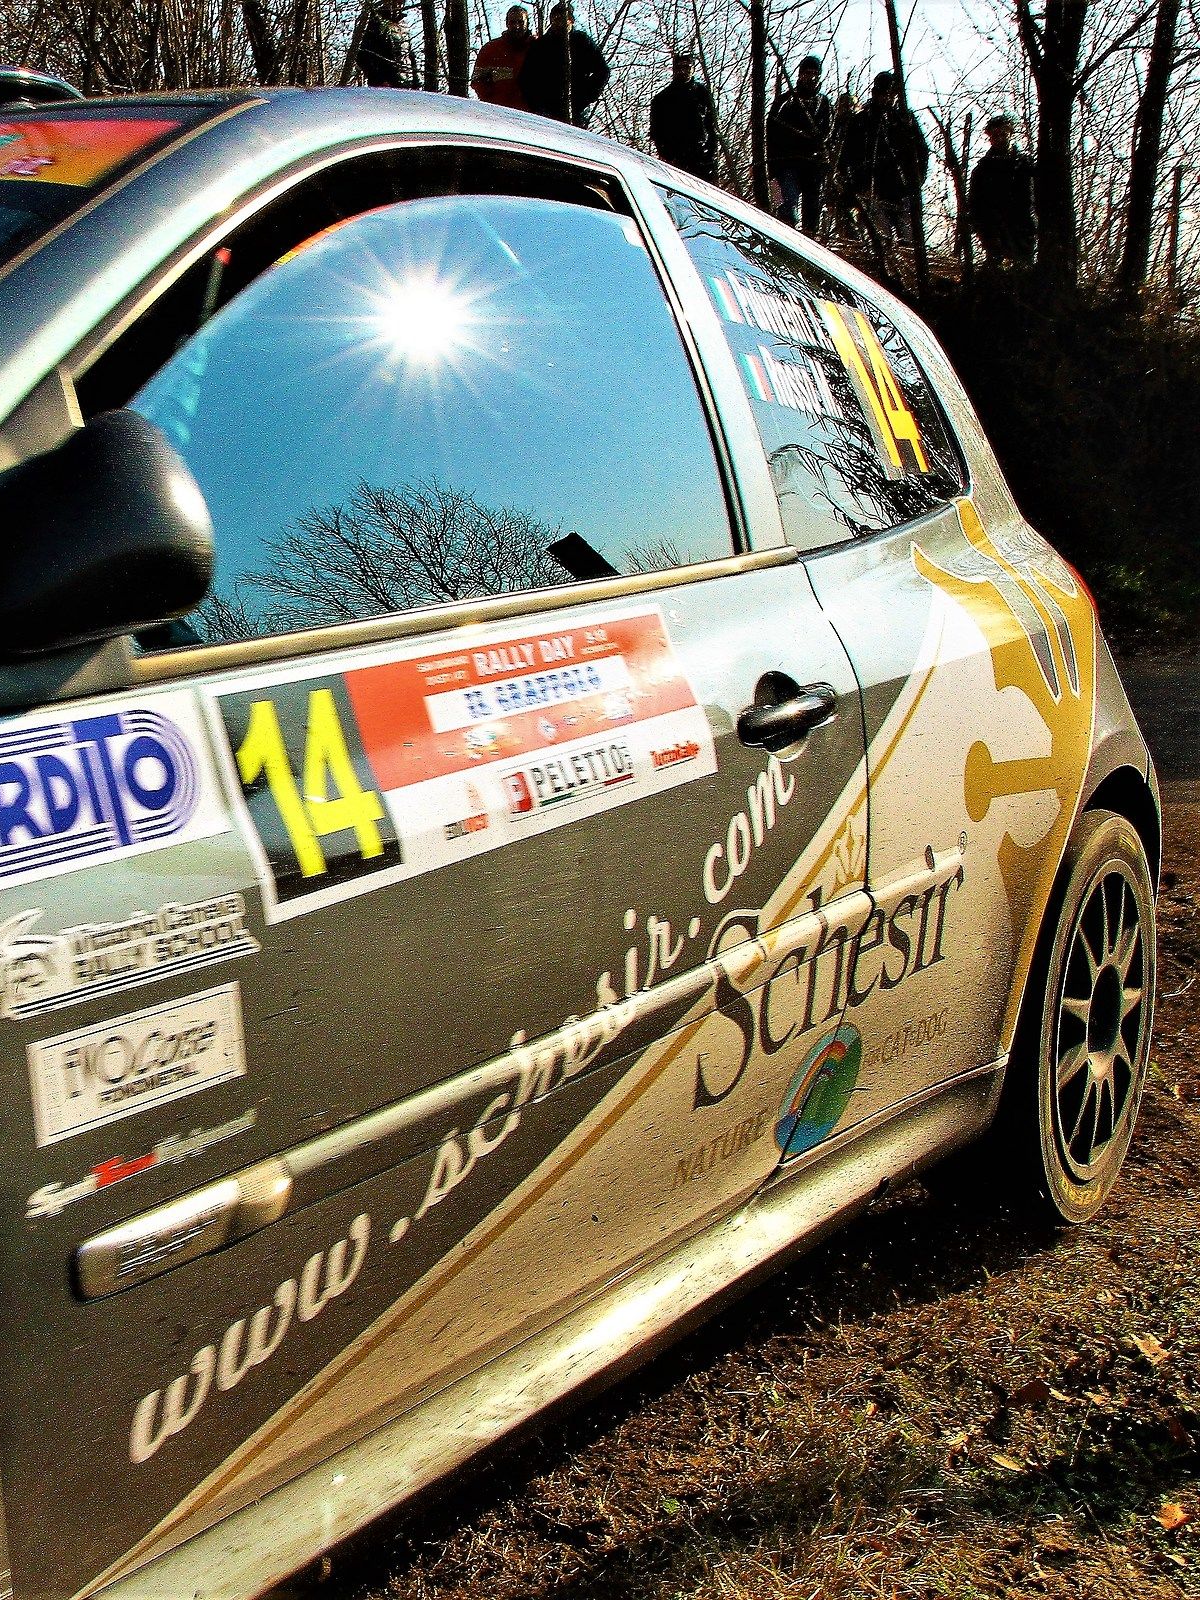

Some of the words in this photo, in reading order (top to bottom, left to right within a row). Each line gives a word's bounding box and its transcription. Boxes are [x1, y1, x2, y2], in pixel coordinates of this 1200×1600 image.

[814, 299, 929, 473] 14
[473, 643, 535, 677] RALLY
[539, 635, 575, 663] DAY
[236, 688, 385, 878] 14
[530, 744, 628, 798] PELETTO
[672, 1109, 770, 1189] NATURE
